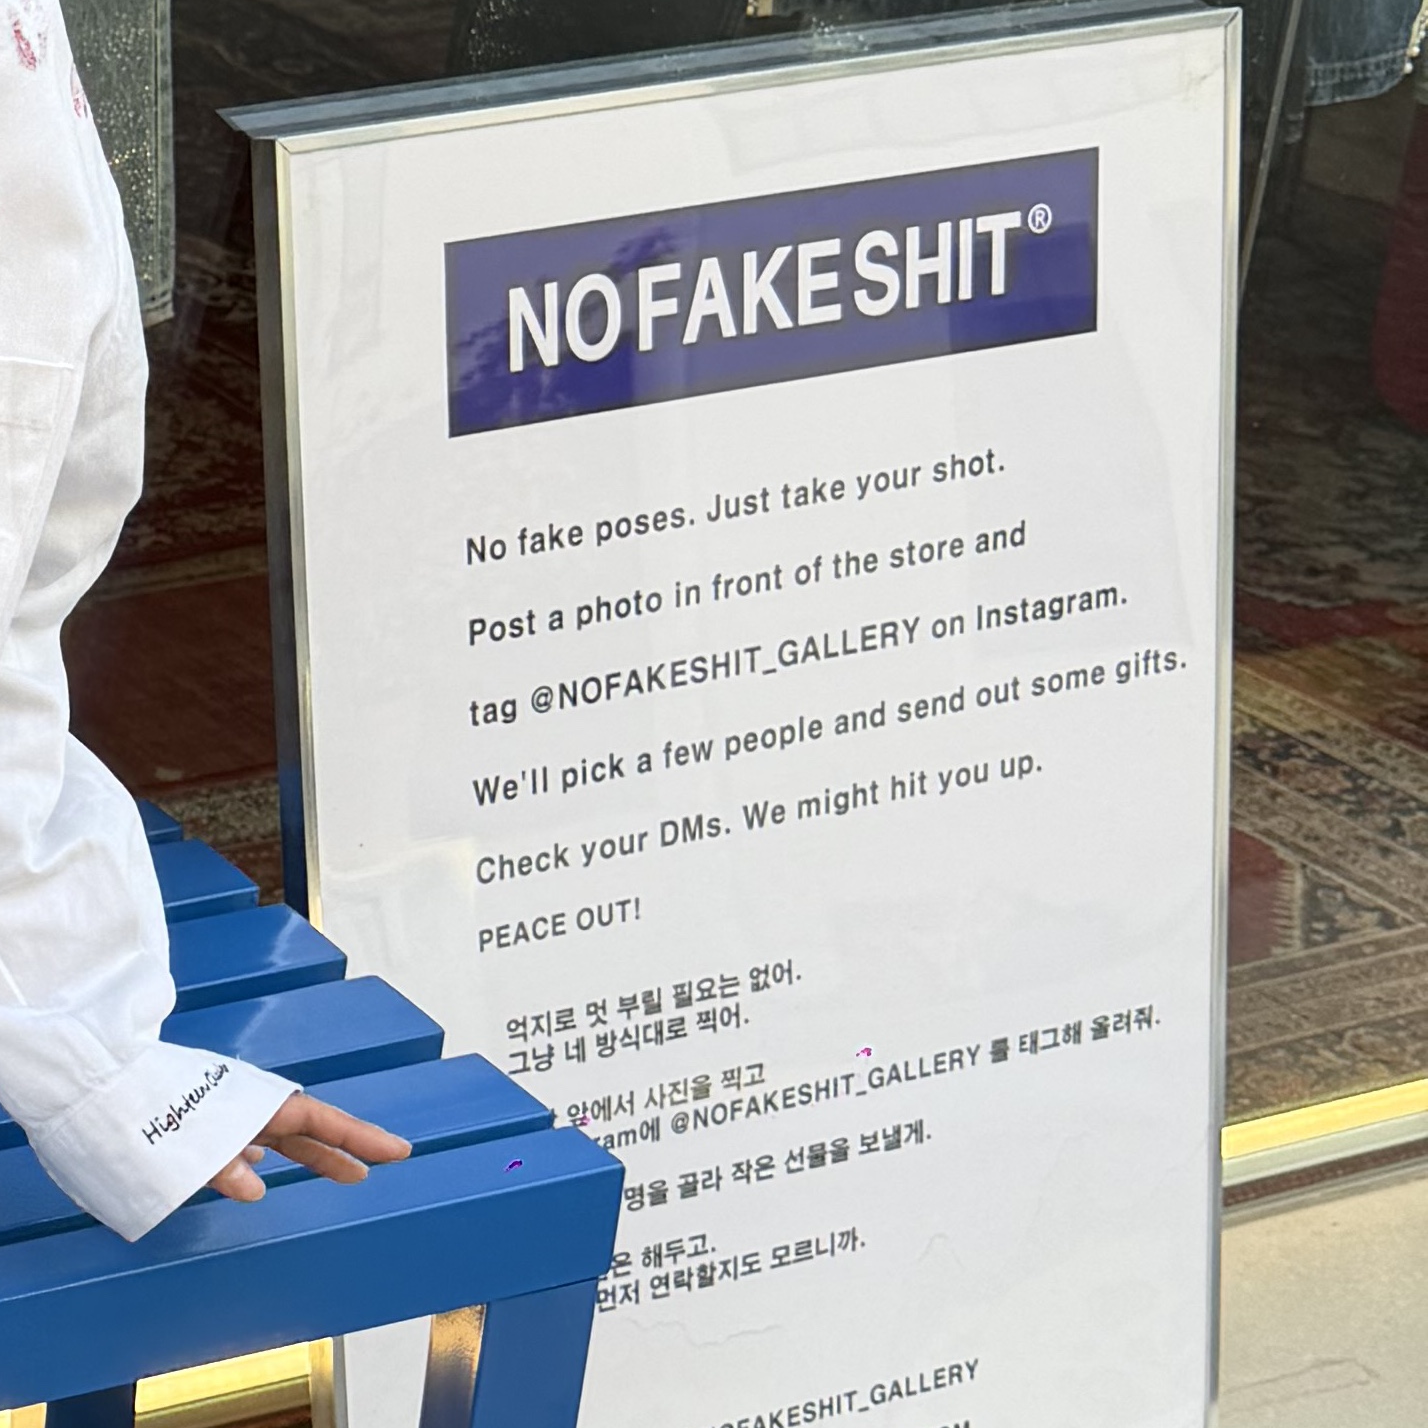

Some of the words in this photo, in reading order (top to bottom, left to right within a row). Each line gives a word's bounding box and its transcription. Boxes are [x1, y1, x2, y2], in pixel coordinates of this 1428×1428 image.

[466, 534, 507, 566] No
[516, 522, 584, 557] fake
[595, 507, 695, 548] poses.
[706, 486, 770, 523] Just
[780, 476, 846, 510] take
[855, 465, 922, 501] your
[932, 448, 1005, 483] shot.
[468, 608, 537, 647] Post
[547, 609, 564, 632] a
[576, 589, 663, 632] photo
[675, 580, 701, 609] in
[711, 564, 783, 602] front
[794, 554, 823, 586] of
[832, 550, 879, 580] the
[889, 537, 965, 569] store
[974, 519, 1026, 555] and
[468, 698, 518, 727] tag
[530, 615, 921, 714] @NOFAKESHIT_GALLERY
[931, 614, 965, 640] on
[976, 586, 1128, 632] Instagram.
[471, 765, 549, 807] We'll
[561, 752, 626, 795] pick
[636, 752, 653, 775] a
[662, 739, 714, 770] few
[724, 715, 824, 762] people
[834, 700, 886, 736] and
[896, 684, 965, 723] send
[975, 676, 1021, 708] out
[1030, 665, 1106, 697] some
[1115, 648, 1187, 685] gifts.
[476, 842, 570, 885] Check
[580, 830, 649, 868] your
[659, 813, 731, 848] DMs.
[742, 799, 787, 831] We
[797, 780, 880, 821] might
[890, 770, 928, 802] hit
[937, 762, 989, 796] you
[1000, 754, 1043, 781] up.
[478, 911, 567, 953] PEACE
[575, 896, 641, 932] OUT!
[506, 1006, 578, 1043] 억지로
[585, 997, 609, 1029] 멋
[616, 986, 663, 1022] 부릴
[672, 973, 741, 1010] 필요는
[748, 958, 802, 993] 없어.
[507, 1042, 556, 1076] 그냥
[563, 1035, 587, 1064] 네
[595, 1015, 689, 1059] 방식대로
[695, 1002, 750, 1034] 찍어.
[643, 1073, 713, 1111] 사진을
[720, 1062, 766, 1092] 찍고
[670, 1044, 981, 1135] @NOFAKESHIT_GALLERY
[988, 1038, 1011, 1065] 를
[1018, 1021, 1083, 1055] 태그해
[1089, 1005, 1161, 1042] 올려줘.
[676, 1165, 724, 1200] 골라
[730, 1154, 777, 1185] 작은
[783, 1136, 851, 1175] 선물을
[857, 1118, 932, 1156] 보낼게.
[640, 1233, 717, 1270] 해두고.
[649, 1251, 763, 1301] 연락할지도
[769, 1226, 866, 1270] 모르니까.
